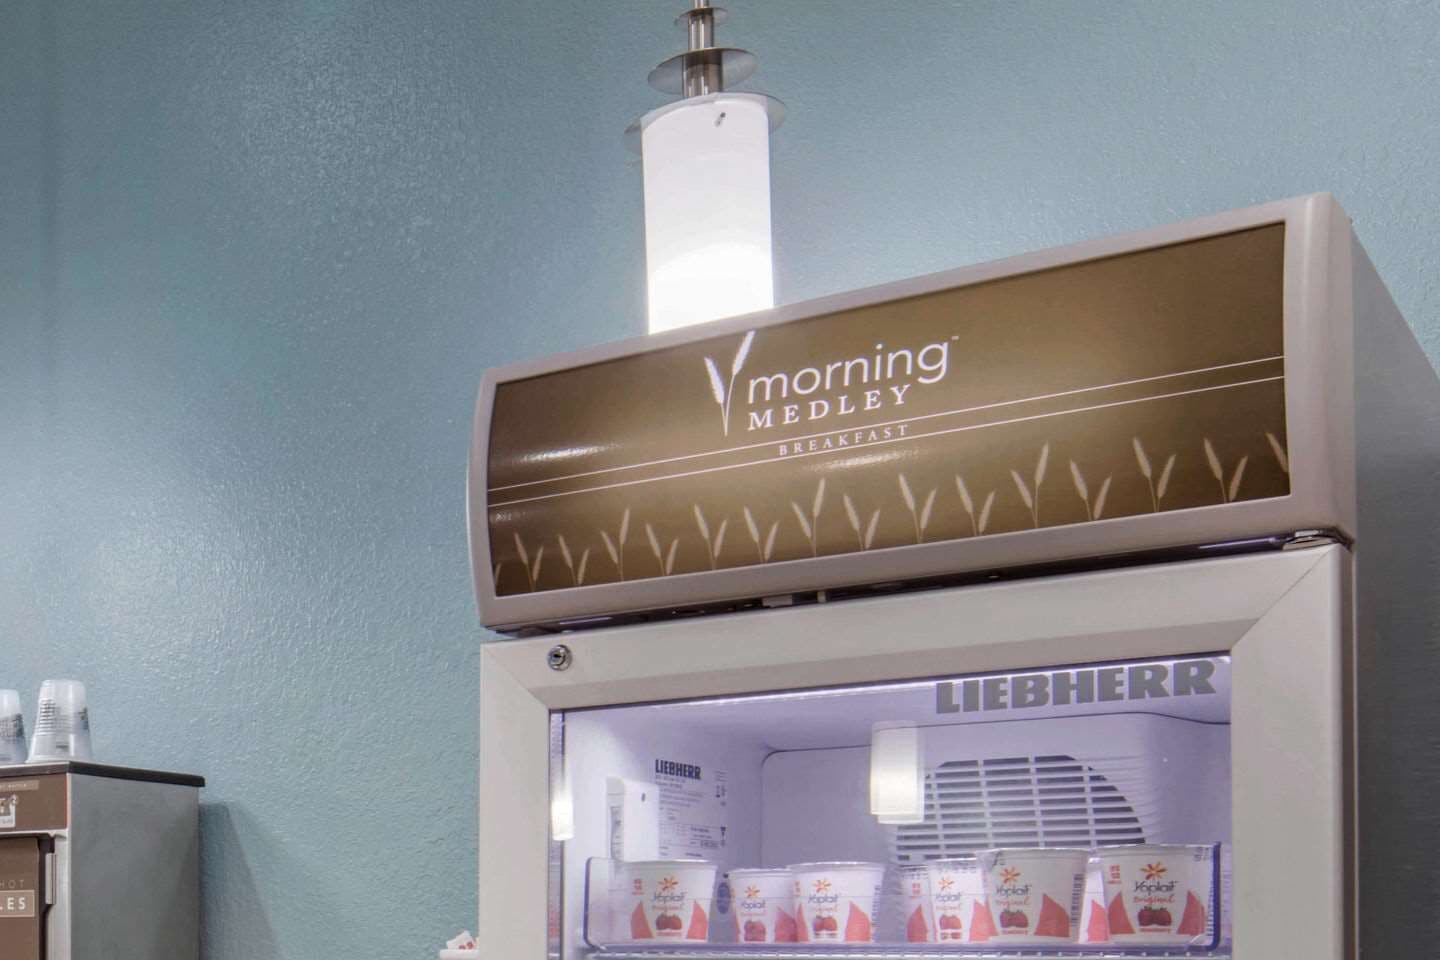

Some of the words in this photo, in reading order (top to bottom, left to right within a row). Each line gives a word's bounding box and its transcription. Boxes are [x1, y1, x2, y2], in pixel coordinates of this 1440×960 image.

[748, 342, 949, 404] morning
[747, 384, 910, 432] MEDLEY
[779, 424, 909, 456] BREAKFAST
[936, 660, 1216, 714] LIEBHERR
[655, 759, 702, 780] LIEBHERR
